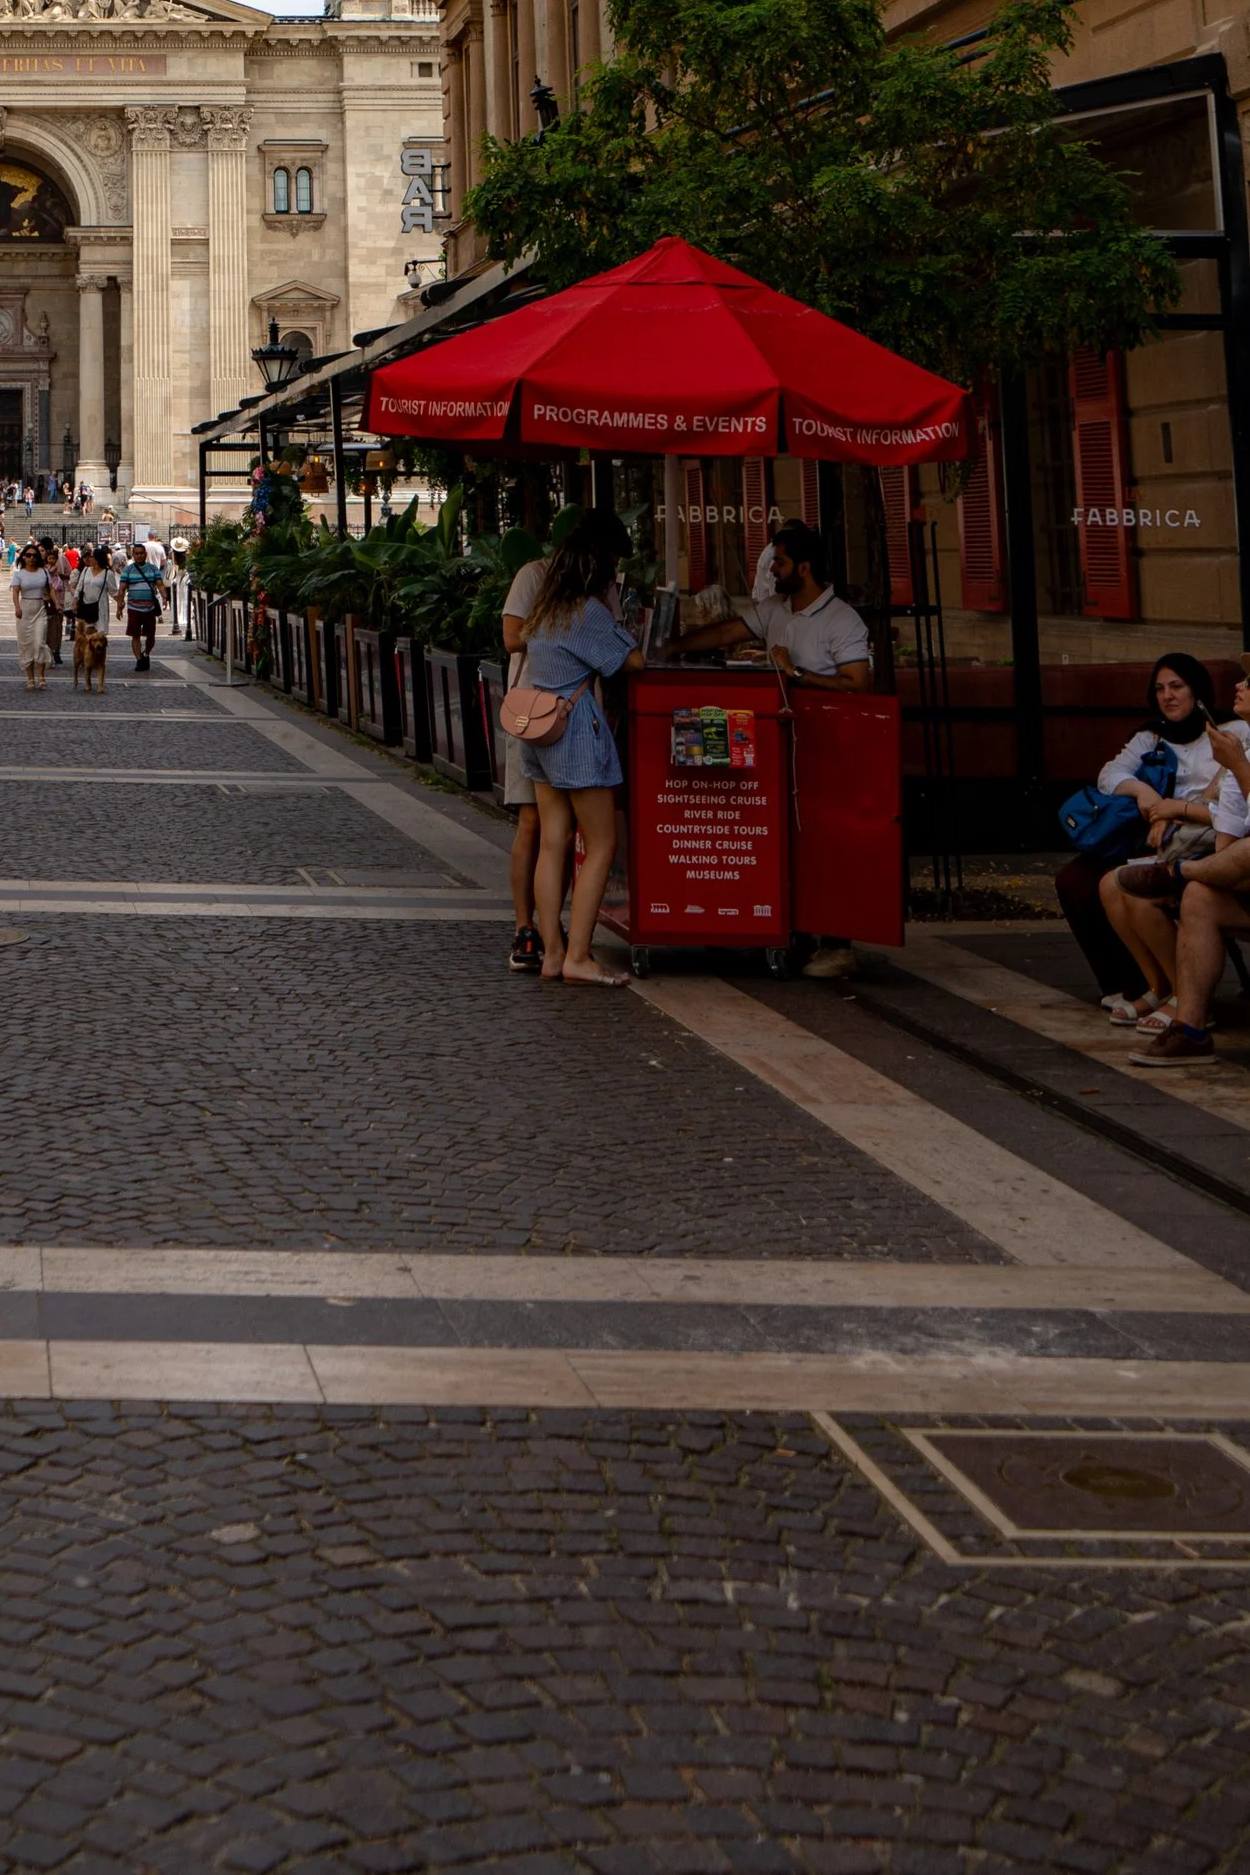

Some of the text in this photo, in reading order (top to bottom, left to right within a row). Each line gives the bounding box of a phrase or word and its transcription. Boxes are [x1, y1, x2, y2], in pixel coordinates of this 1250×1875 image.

[379, 397, 510, 417] TOURIST INFORMATION
[533, 404, 767, 433] PROGRAMMES & EVENTS
[792, 417, 959, 445] TOURIST INFORMATION
[1070, 508, 1201, 527] FABBRICA
[665, 779, 759, 790] HOP ON-HOP OFF
[657, 794, 767, 805] SIGHTSEEING CRUISE
[684, 810, 740, 819] RIVER RIDE
[656, 824, 768, 835] COUNTRYSIDE TOURS
[672, 839, 753, 850] DINNER CRUISE
[669, 855, 757, 865] WALKING TOURS
[686, 870, 740, 880] MUSEUMS
